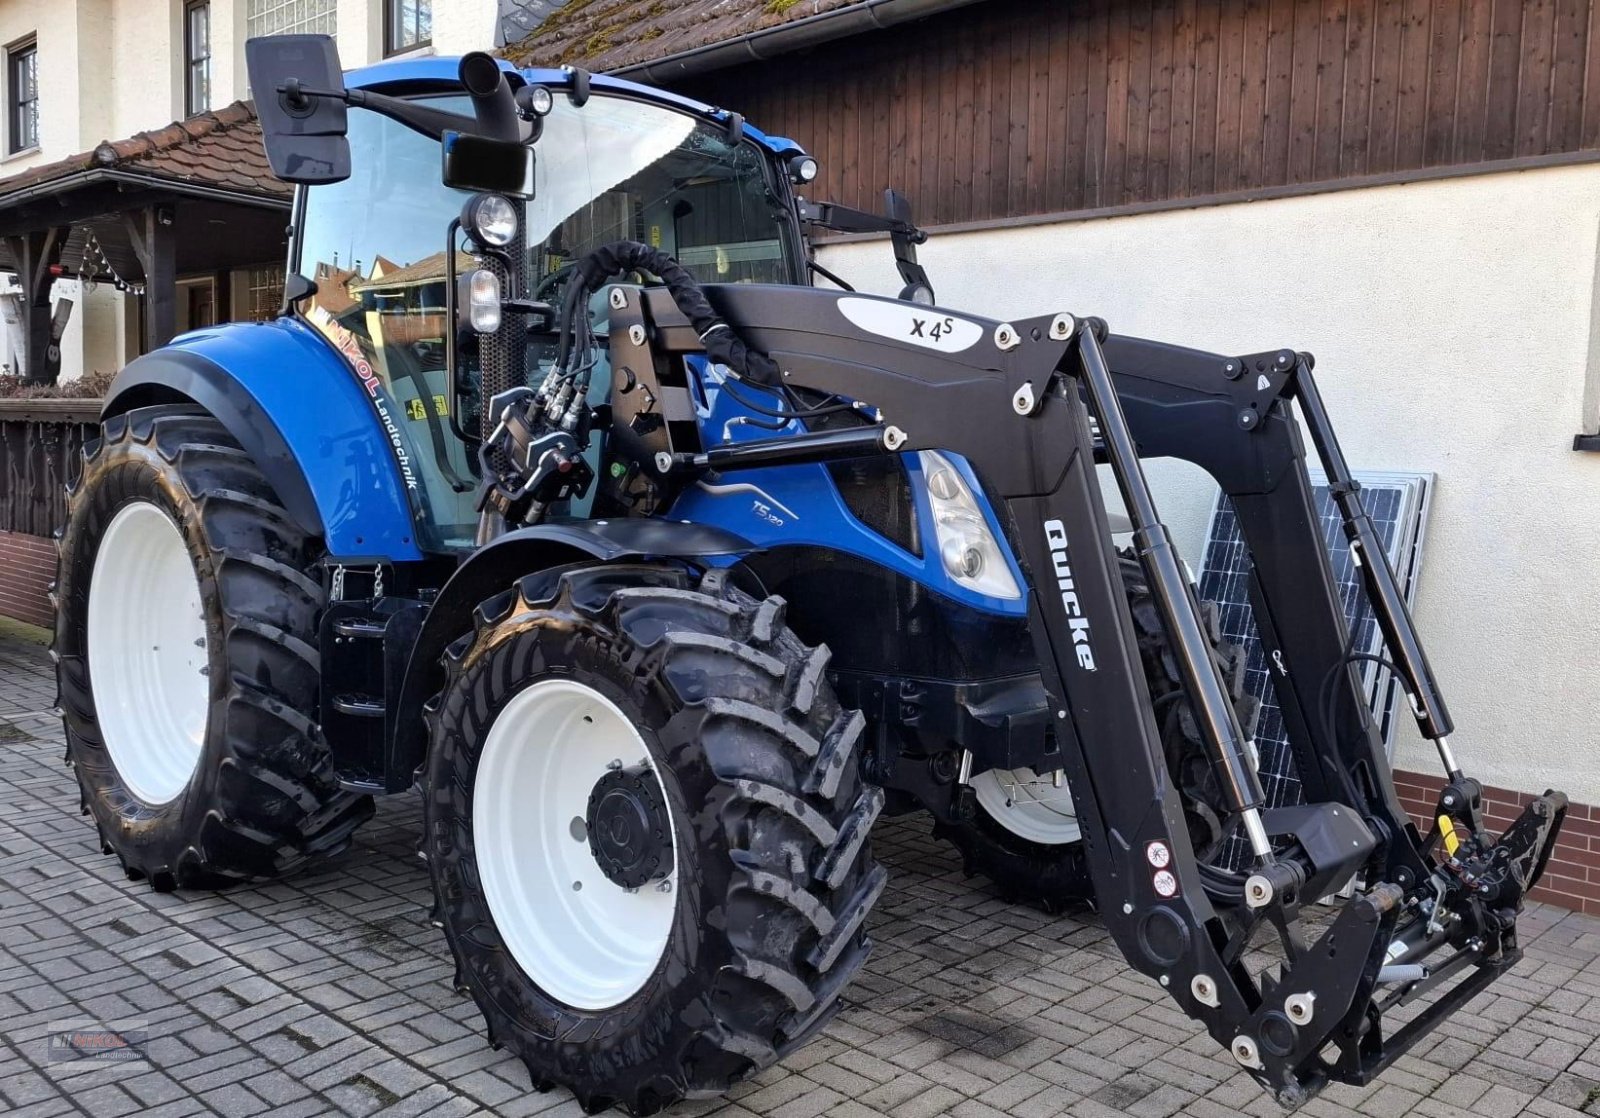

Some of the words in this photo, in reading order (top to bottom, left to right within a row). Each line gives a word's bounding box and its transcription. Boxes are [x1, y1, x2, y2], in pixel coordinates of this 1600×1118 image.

[326, 318, 380, 398] NIKOL
[375, 398, 418, 490] Landtechnik
[1044, 519, 1096, 671] Quicke
